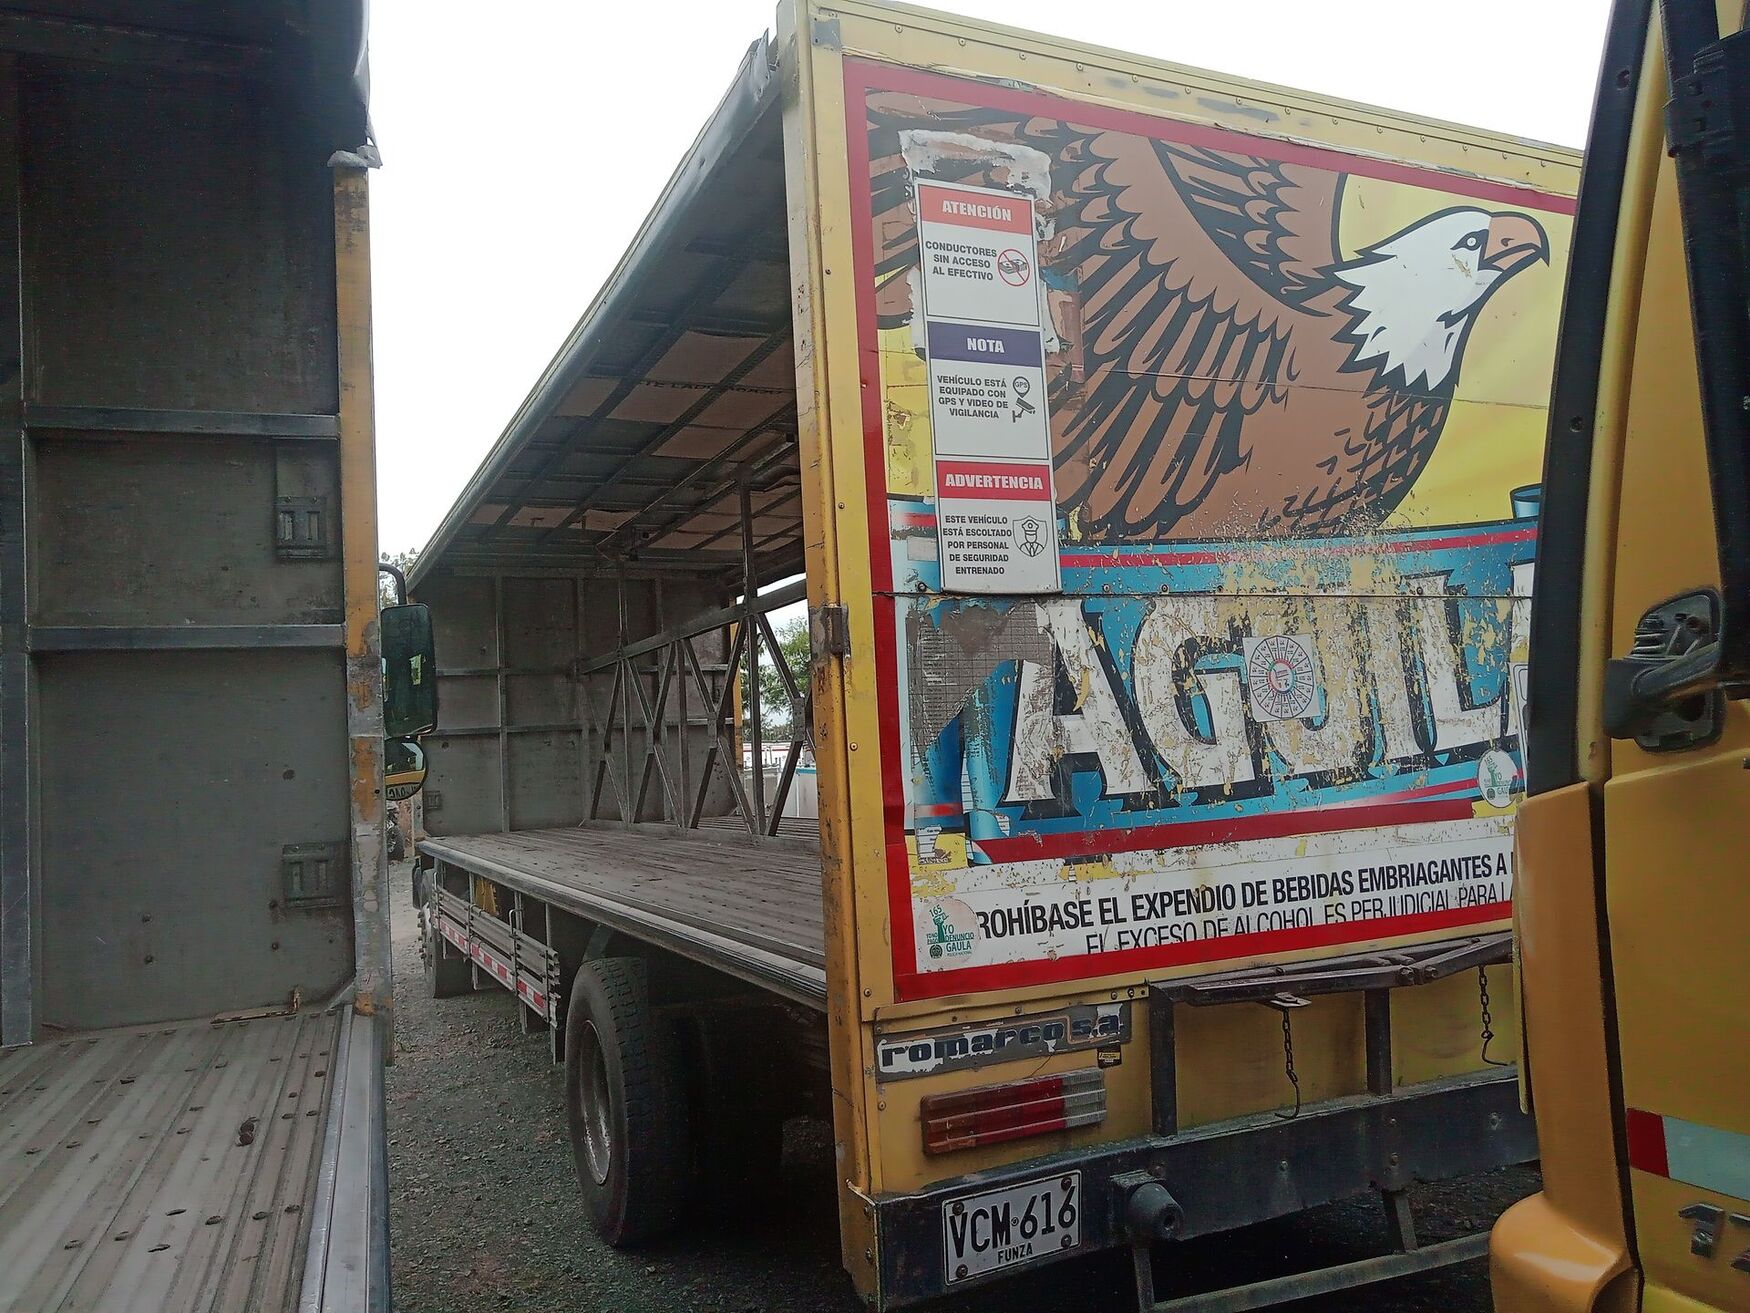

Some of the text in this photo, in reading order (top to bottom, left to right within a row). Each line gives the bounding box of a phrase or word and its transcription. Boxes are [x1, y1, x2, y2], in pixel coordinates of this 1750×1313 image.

[942, 200, 1012, 222] ATENCIÓN
[925, 240, 997, 258] CONDUCTORES
[933, 254, 991, 269] SIN ACCESO
[932, 266, 994, 281] AL EFECTIVO
[967, 338, 1005, 354] NOTA
[937, 374, 1007, 388] VEHÍCULO ESTÁ
[939, 386, 1006, 398] EQUIPADO CON
[938, 397, 1008, 409] GPS Y VIDEO DE
[949, 408, 999, 419] VIGILANCIA
[945, 473, 1043, 490] ADVERTENCIA
[945, 514, 1008, 525] ESTE VEHÍCULO
[943, 527, 1012, 537] ESTÁ ESCOLTADO
[947, 541, 1009, 550] POR PERSONAL
[949, 553, 1009, 562] DE SEGURIDAD
[955, 566, 1005, 575] ENTRENADO
[1003, 558, 1536, 804] AGUIL
[976, 899, 1094, 939] ROHÍBASE
[1100, 896, 1127, 926] EL
[1132, 883, 1236, 922] EXPENDIO
[1241, 880, 1268, 908] DE
[1272, 870, 1354, 905] BEBIDAS
[1358, 854, 1493, 894] EMBRIAGANTES
[1496, 853, 1507, 875] A
[1117, 922, 1197, 950] EXCESO
[1459, 882, 1497, 908] PARA
[943, 924, 955, 934] YO
[946, 941, 972, 952] GAULA
[882, 1023, 1065, 1067] romarco
[949, 1185, 1077, 1258] VCM 616
[997, 1242, 1033, 1264] FUNZA
